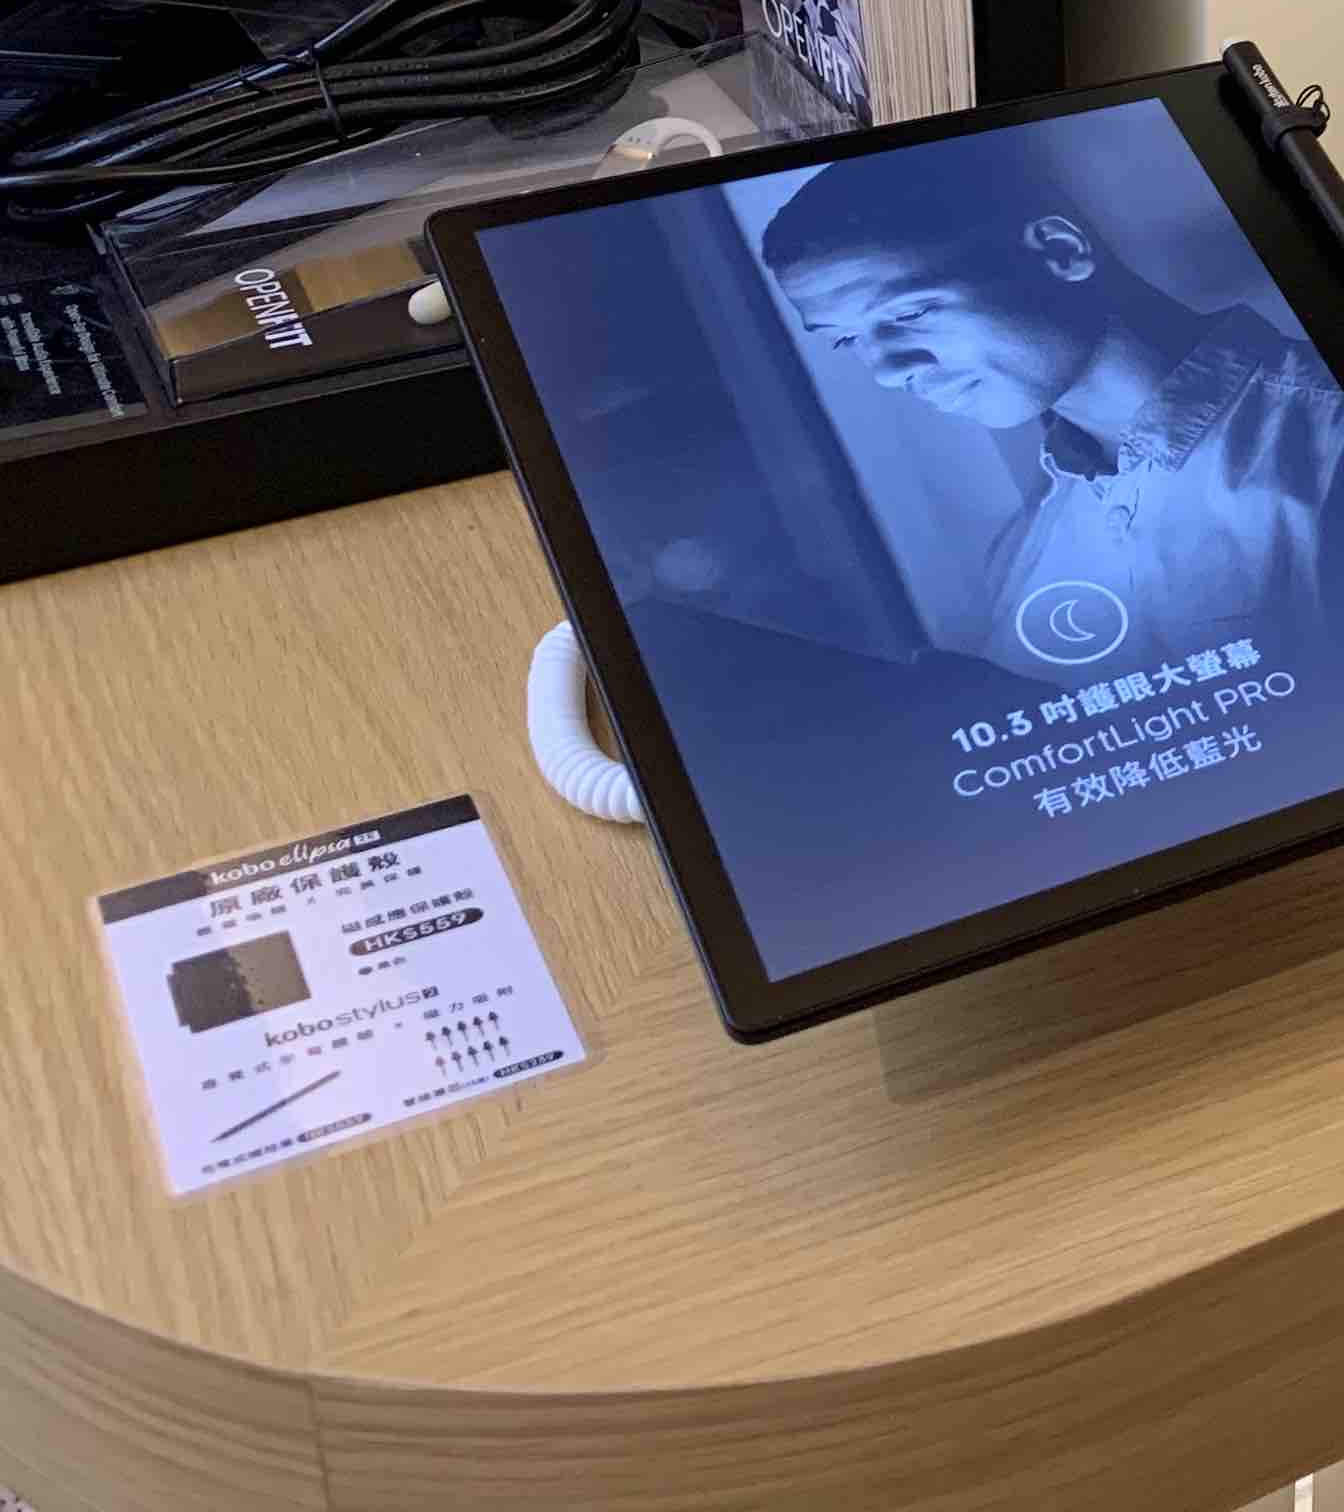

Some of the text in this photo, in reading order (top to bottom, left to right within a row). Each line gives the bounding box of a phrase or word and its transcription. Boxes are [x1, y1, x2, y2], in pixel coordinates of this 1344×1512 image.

[234, 268, 313, 350] OPENFIT
[951, 638, 1262, 754] 10.3 吋護眼大螢幕
[952, 671, 1296, 799] ComfortLight PRO
[1032, 723, 1263, 819] 有效降低藍光
[209, 859, 277, 887] kobo
[278, 837, 352, 870] elipsa
[263, 1016, 334, 1049] kobo
[334, 990, 423, 1027] stylus
